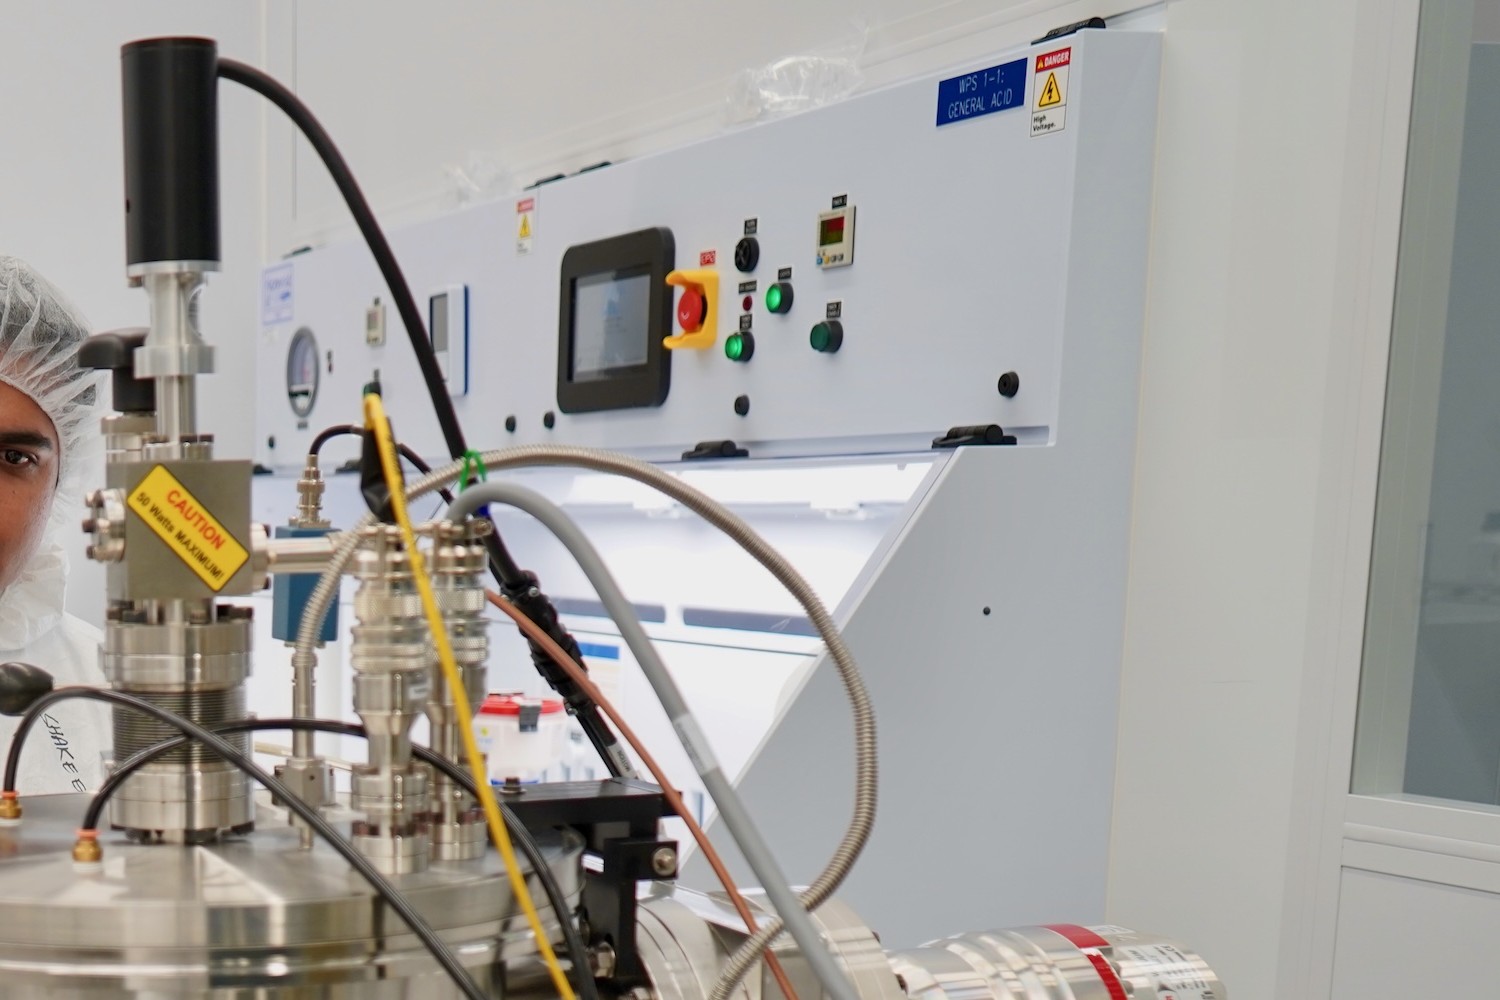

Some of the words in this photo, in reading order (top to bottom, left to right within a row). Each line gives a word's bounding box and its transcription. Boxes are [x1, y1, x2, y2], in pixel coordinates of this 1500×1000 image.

[1044, 52, 1069, 66] DANGER
[959, 76, 977, 94] WPS
[984, 69, 1004, 86] 1-1:
[948, 97, 985, 119] GENERAL
[991, 88, 1013, 108] ACID
[1033, 115, 1047, 124] High
[1033, 122, 1056, 133] Voltage.
[167, 490, 225, 550] CAUTION
[137, 492, 151, 506] 50
[150, 503, 175, 533] Watts
[174, 529, 225, 581] MAXIMUM!
